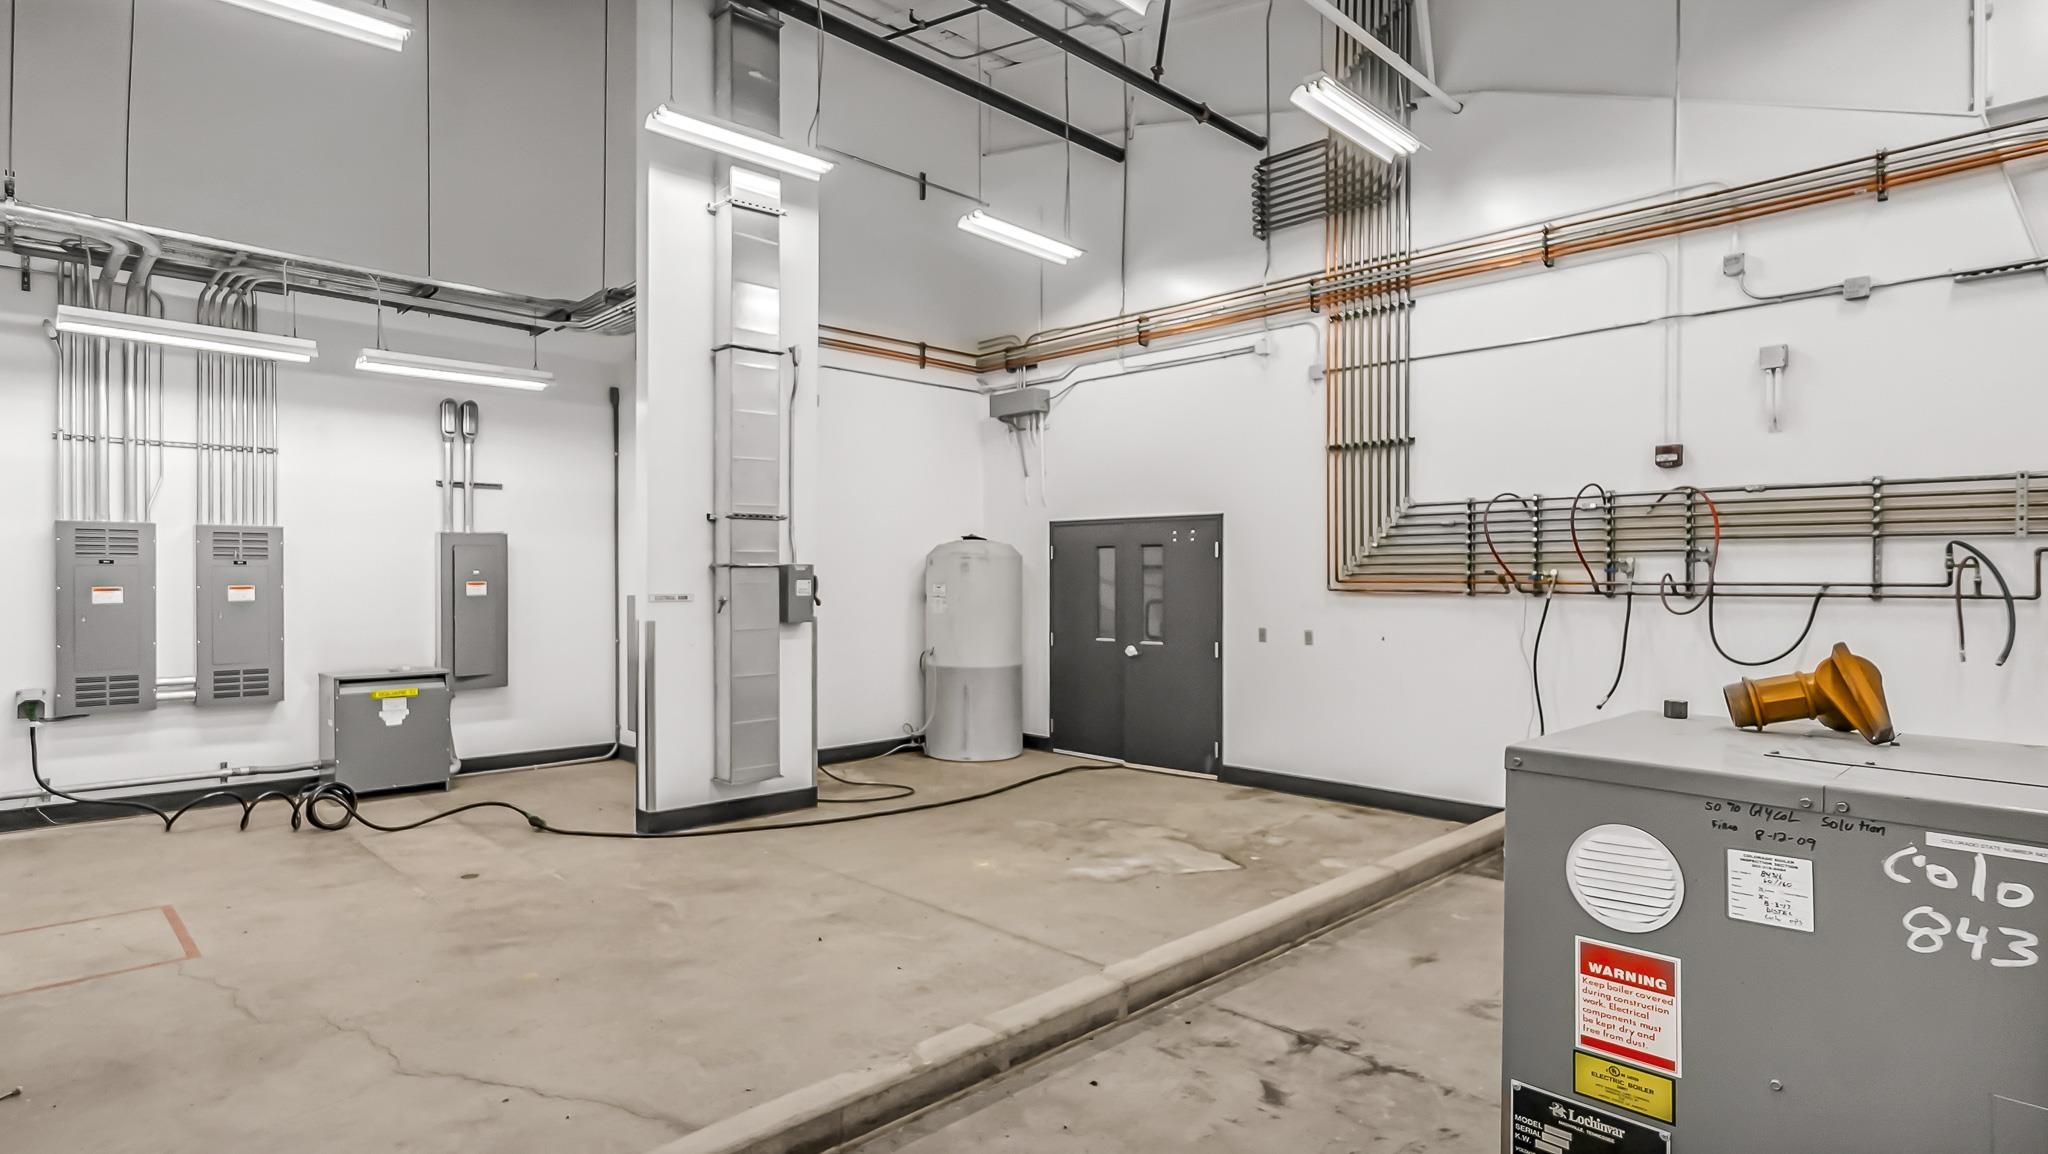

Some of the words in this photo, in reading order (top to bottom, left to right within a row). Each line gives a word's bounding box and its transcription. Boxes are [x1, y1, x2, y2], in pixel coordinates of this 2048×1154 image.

[1754, 829, 1817, 851] 8-12-09
[1902, 905, 2039, 968] 843
[1588, 961, 1667, 991] WARNING
[1582, 976, 1605, 989] Keep
[1606, 982, 1633, 996] boiler
[1635, 992, 1674, 1006] covered
[1582, 987, 1612, 1001] during
[1613, 996, 1670, 1015] construction
[1582, 997, 1606, 1009] work.
[1608, 1002, 1650, 1020] Electrical
[1582, 1006, 1637, 1026] components
[1640, 1021, 1662, 1033] must
[1582, 1014, 1594, 1024] be
[1595, 1018, 1616, 1030] kept
[1618, 1024, 1635, 1037] dry
[1637, 1031, 1656, 1041] and
[1582, 1024, 1600, 1035] free
[1603, 1029, 1624, 1041] from
[1625, 1037, 1649, 1049] dust.
[1591, 1071, 1625, 1086] ELECTRIC
[1627, 1082, 1655, 1095] BOILER
[1514, 1113, 1544, 1130] MODEL
[1515, 1123, 1542, 1138] SERIAL
[1567, 1108, 1626, 1139] Lochinvar
[1514, 1132, 1532, 1144] K.W.
